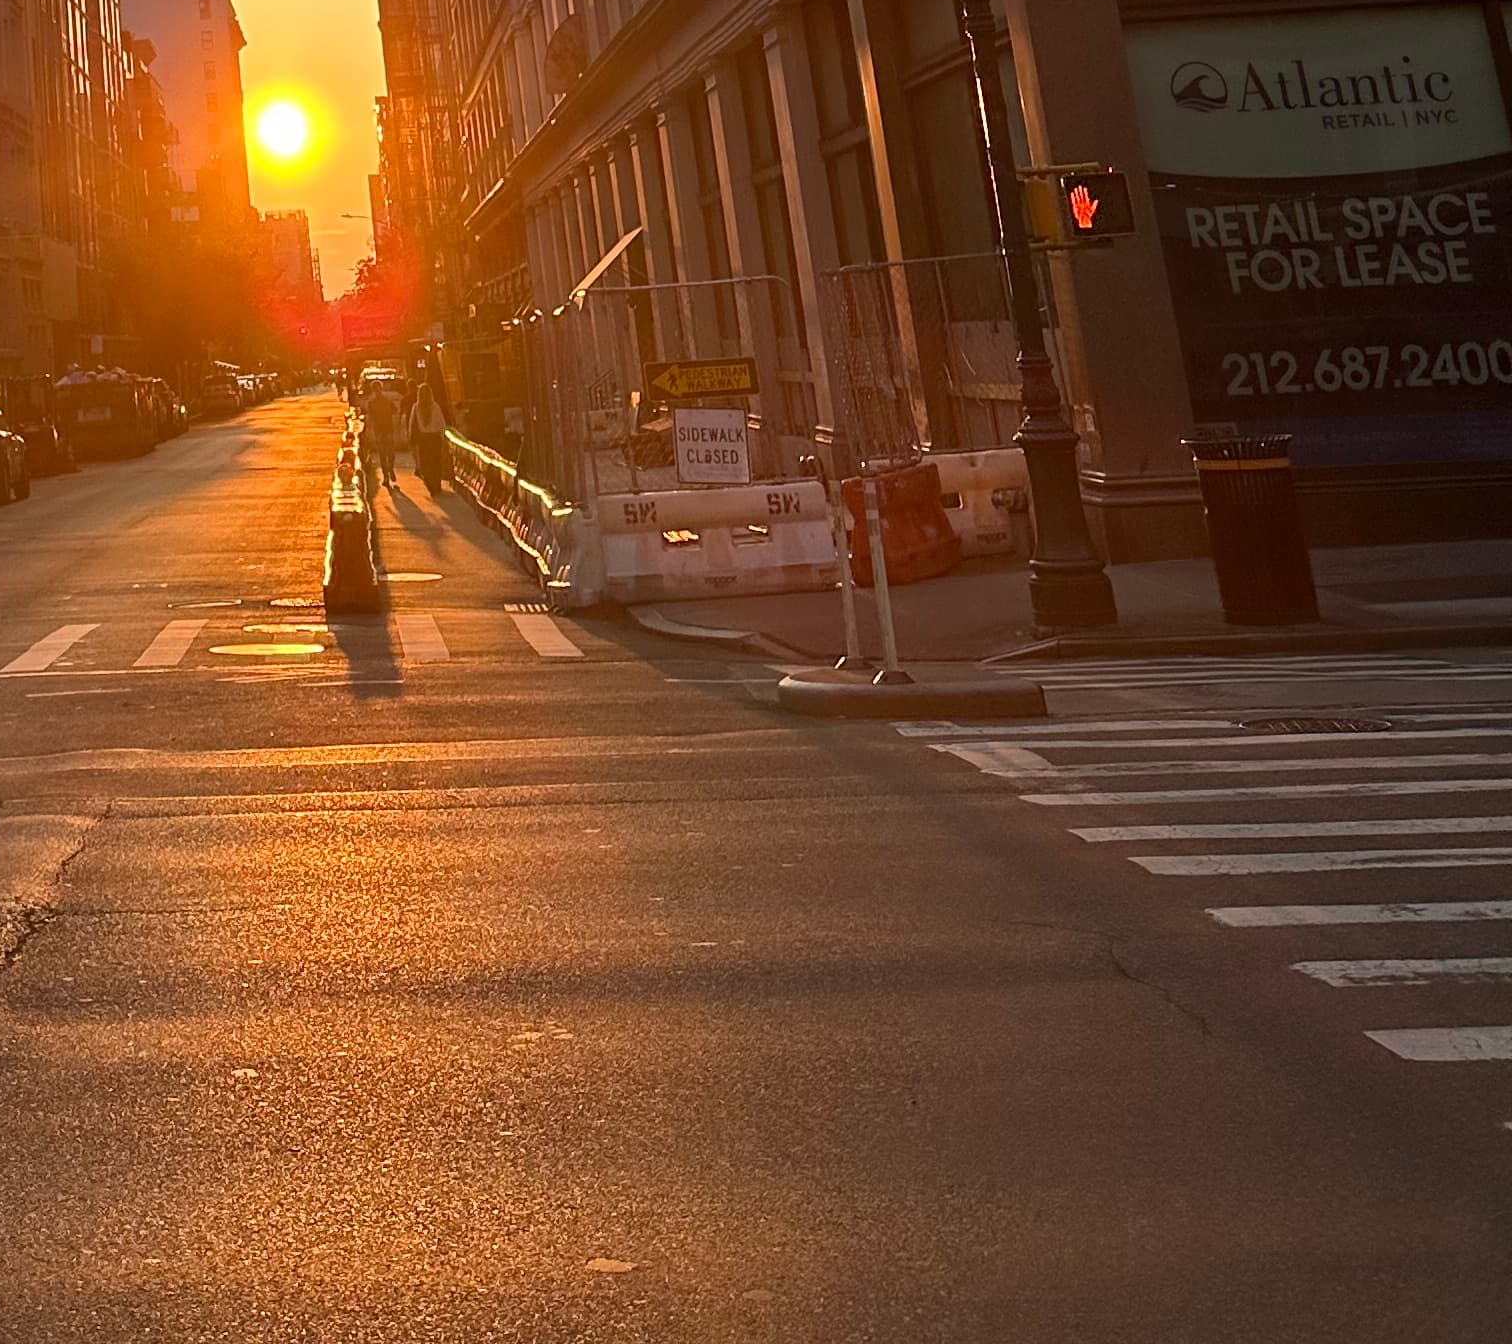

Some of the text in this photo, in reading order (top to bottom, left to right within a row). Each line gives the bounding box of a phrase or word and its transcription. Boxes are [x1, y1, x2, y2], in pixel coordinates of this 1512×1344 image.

[1237, 55, 1454, 112] Atlantic
[1321, 109, 1459, 130] RETAIL NYC
[1184, 191, 1497, 249] RETAIL SPACE
[1225, 240, 1475, 295] FOR LEASE
[678, 366, 748, 380] PEDESTRIAN
[1221, 338, 1512, 397] 212.687.2400
[687, 377, 741, 392] WALKWAY
[678, 427, 745, 444] SIDEWALK
[686, 449, 739, 465] CLOSED
